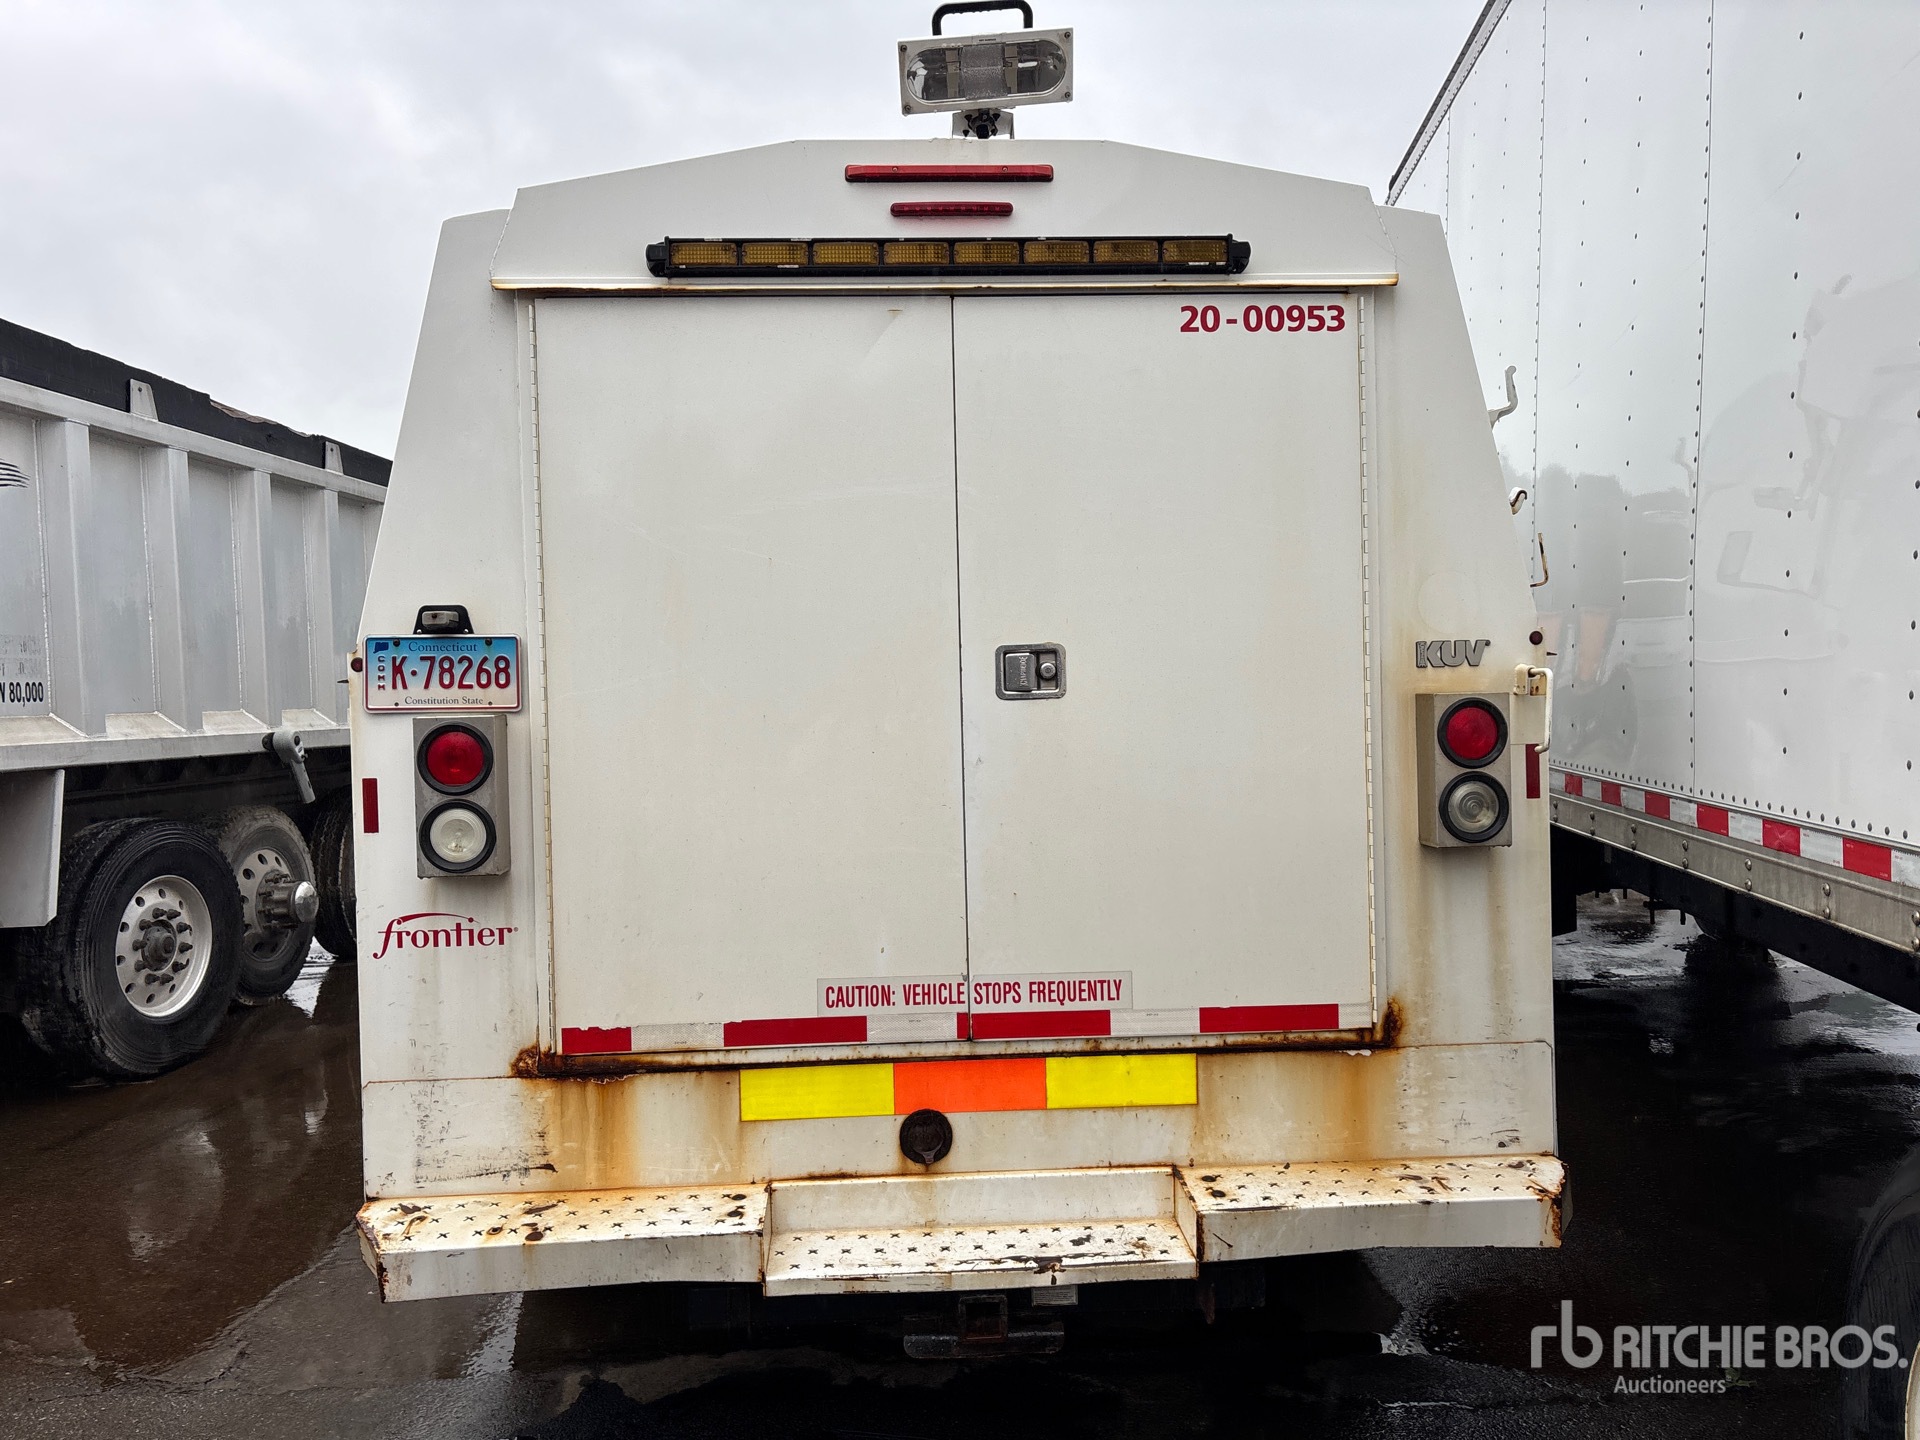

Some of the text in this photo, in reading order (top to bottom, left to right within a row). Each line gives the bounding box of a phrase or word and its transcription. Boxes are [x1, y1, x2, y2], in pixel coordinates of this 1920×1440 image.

[1180, 305, 1345, 332] 20-00953
[408, 641, 478, 652] Connecticut
[1416, 639, 1487, 668] KUV
[377, 655, 386, 691] COMM
[9, 681, 44, 707] 80,000
[404, 696, 483, 705] Constitution State
[372, 917, 514, 959] frontier
[825, 978, 1123, 1009] CAUTION: VEHICLE STOPS FREQUENTLY
